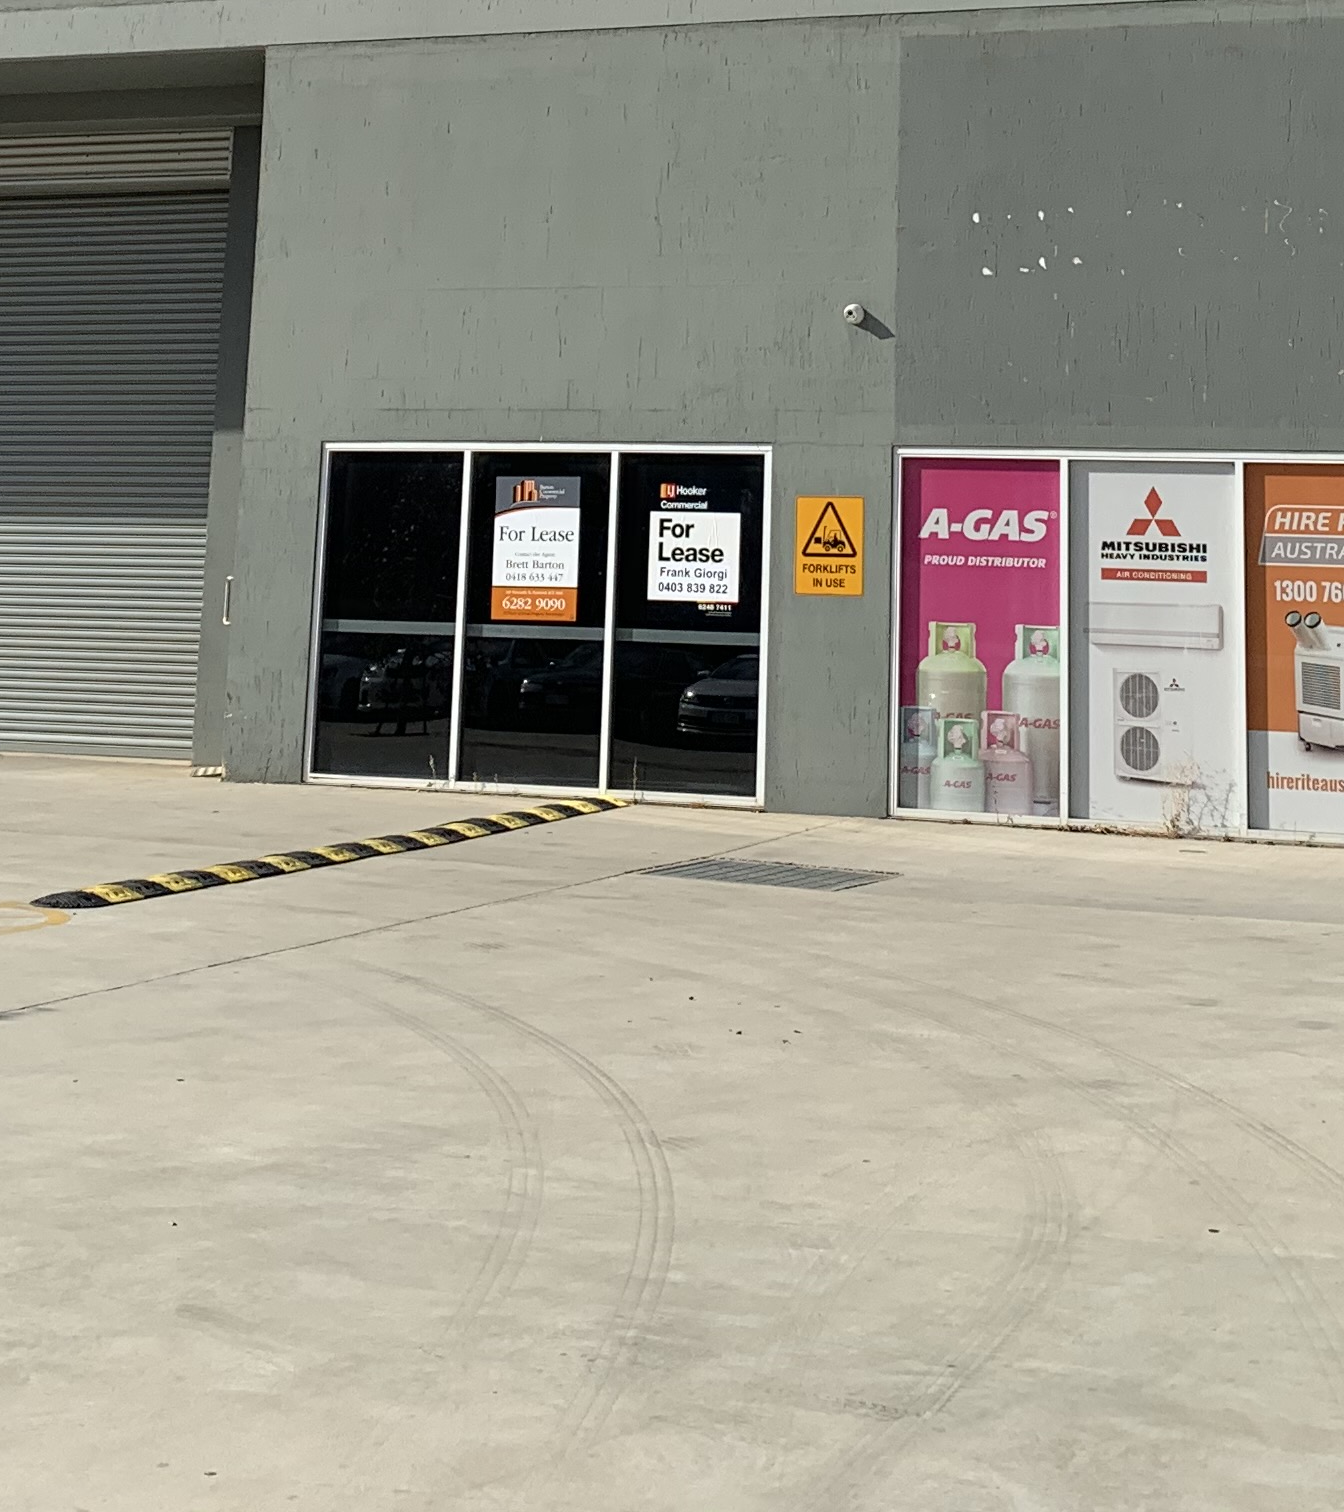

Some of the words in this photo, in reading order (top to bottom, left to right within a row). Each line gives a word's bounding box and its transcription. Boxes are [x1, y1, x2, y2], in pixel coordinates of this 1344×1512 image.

[676, 485, 707, 496] Hooker
[660, 500, 708, 510] Commercial
[1274, 511, 1332, 532] HIRE
[499, 525, 526, 541] For
[531, 526, 575, 542] Lease
[659, 518, 695, 539] For
[658, 541, 724, 563] Lease
[1101, 541, 1208, 554] MITSUBISHI
[924, 555, 965, 566] PROUD
[967, 556, 1046, 569] DISTRIBUTOR
[1101, 552, 1136, 560] HEAVY
[1139, 553, 1207, 563] INDUSTRIES
[506, 559, 529, 569] Brett
[532, 560, 565, 570] Barton
[802, 564, 857, 574] FORKLIFTS
[505, 573, 527, 581] 0418
[659, 567, 690, 578] Frank
[694, 568, 728, 581] Giorgi
[1132, 571, 1193, 581] CONDITIONING
[658, 582, 683, 592] 0403
[686, 583, 706, 593] 839
[708, 584, 728, 594] 822
[812, 578, 823, 588] IN
[825, 578, 846, 588] USE
[1274, 580, 1317, 602] 1300
[502, 596, 532, 610] 6282
[535, 598, 566, 611] 9090
[1018, 716, 1061, 730] A-GAS
[985, 773, 1018, 782] A-GAS
[943, 780, 973, 789] A-GAS
